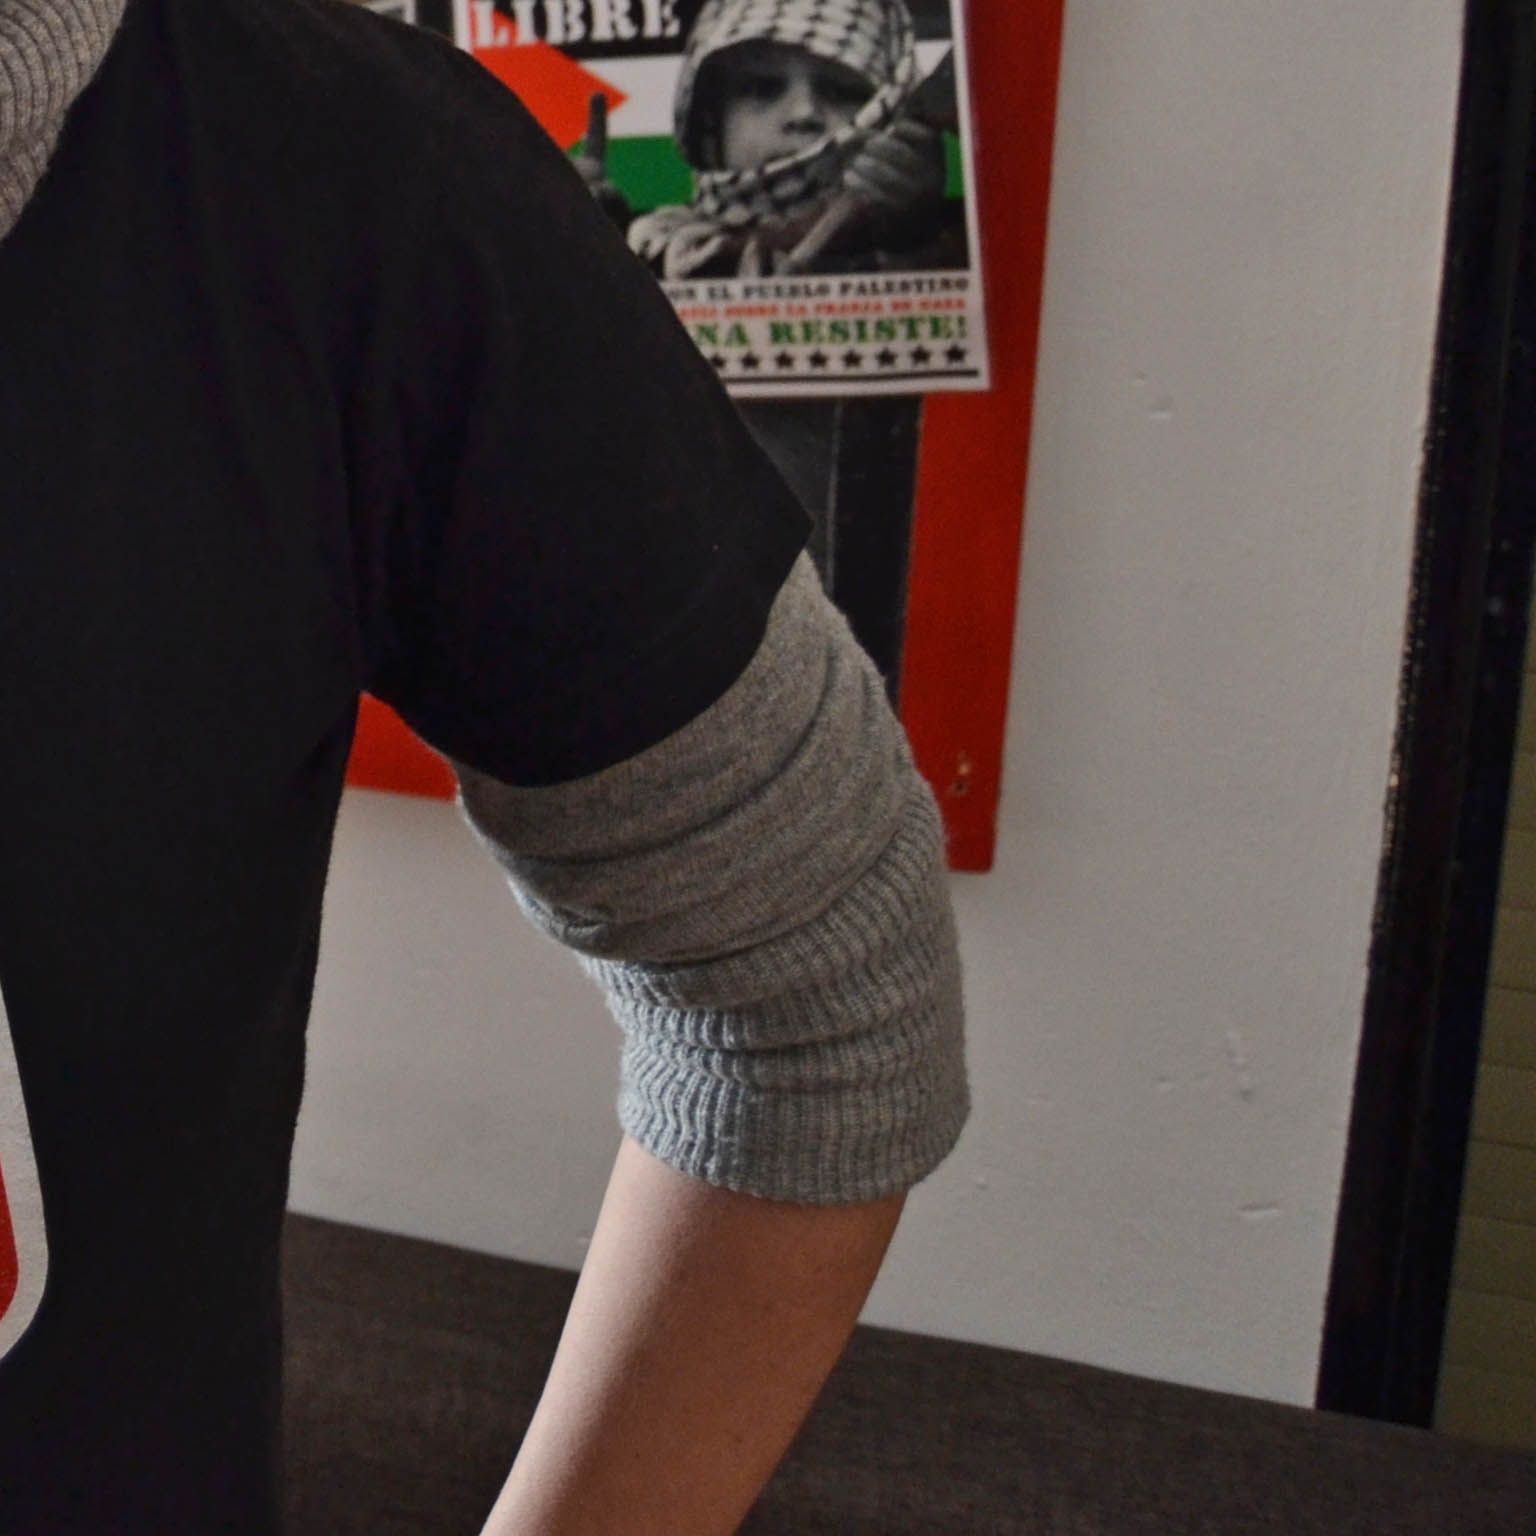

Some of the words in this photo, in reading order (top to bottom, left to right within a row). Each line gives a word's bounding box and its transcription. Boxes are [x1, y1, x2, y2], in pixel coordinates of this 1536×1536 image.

[743, 282, 828, 299] PUEBLO
[840, 276, 970, 297] PALESTINO
[768, 315, 968, 345] RESISTE!
